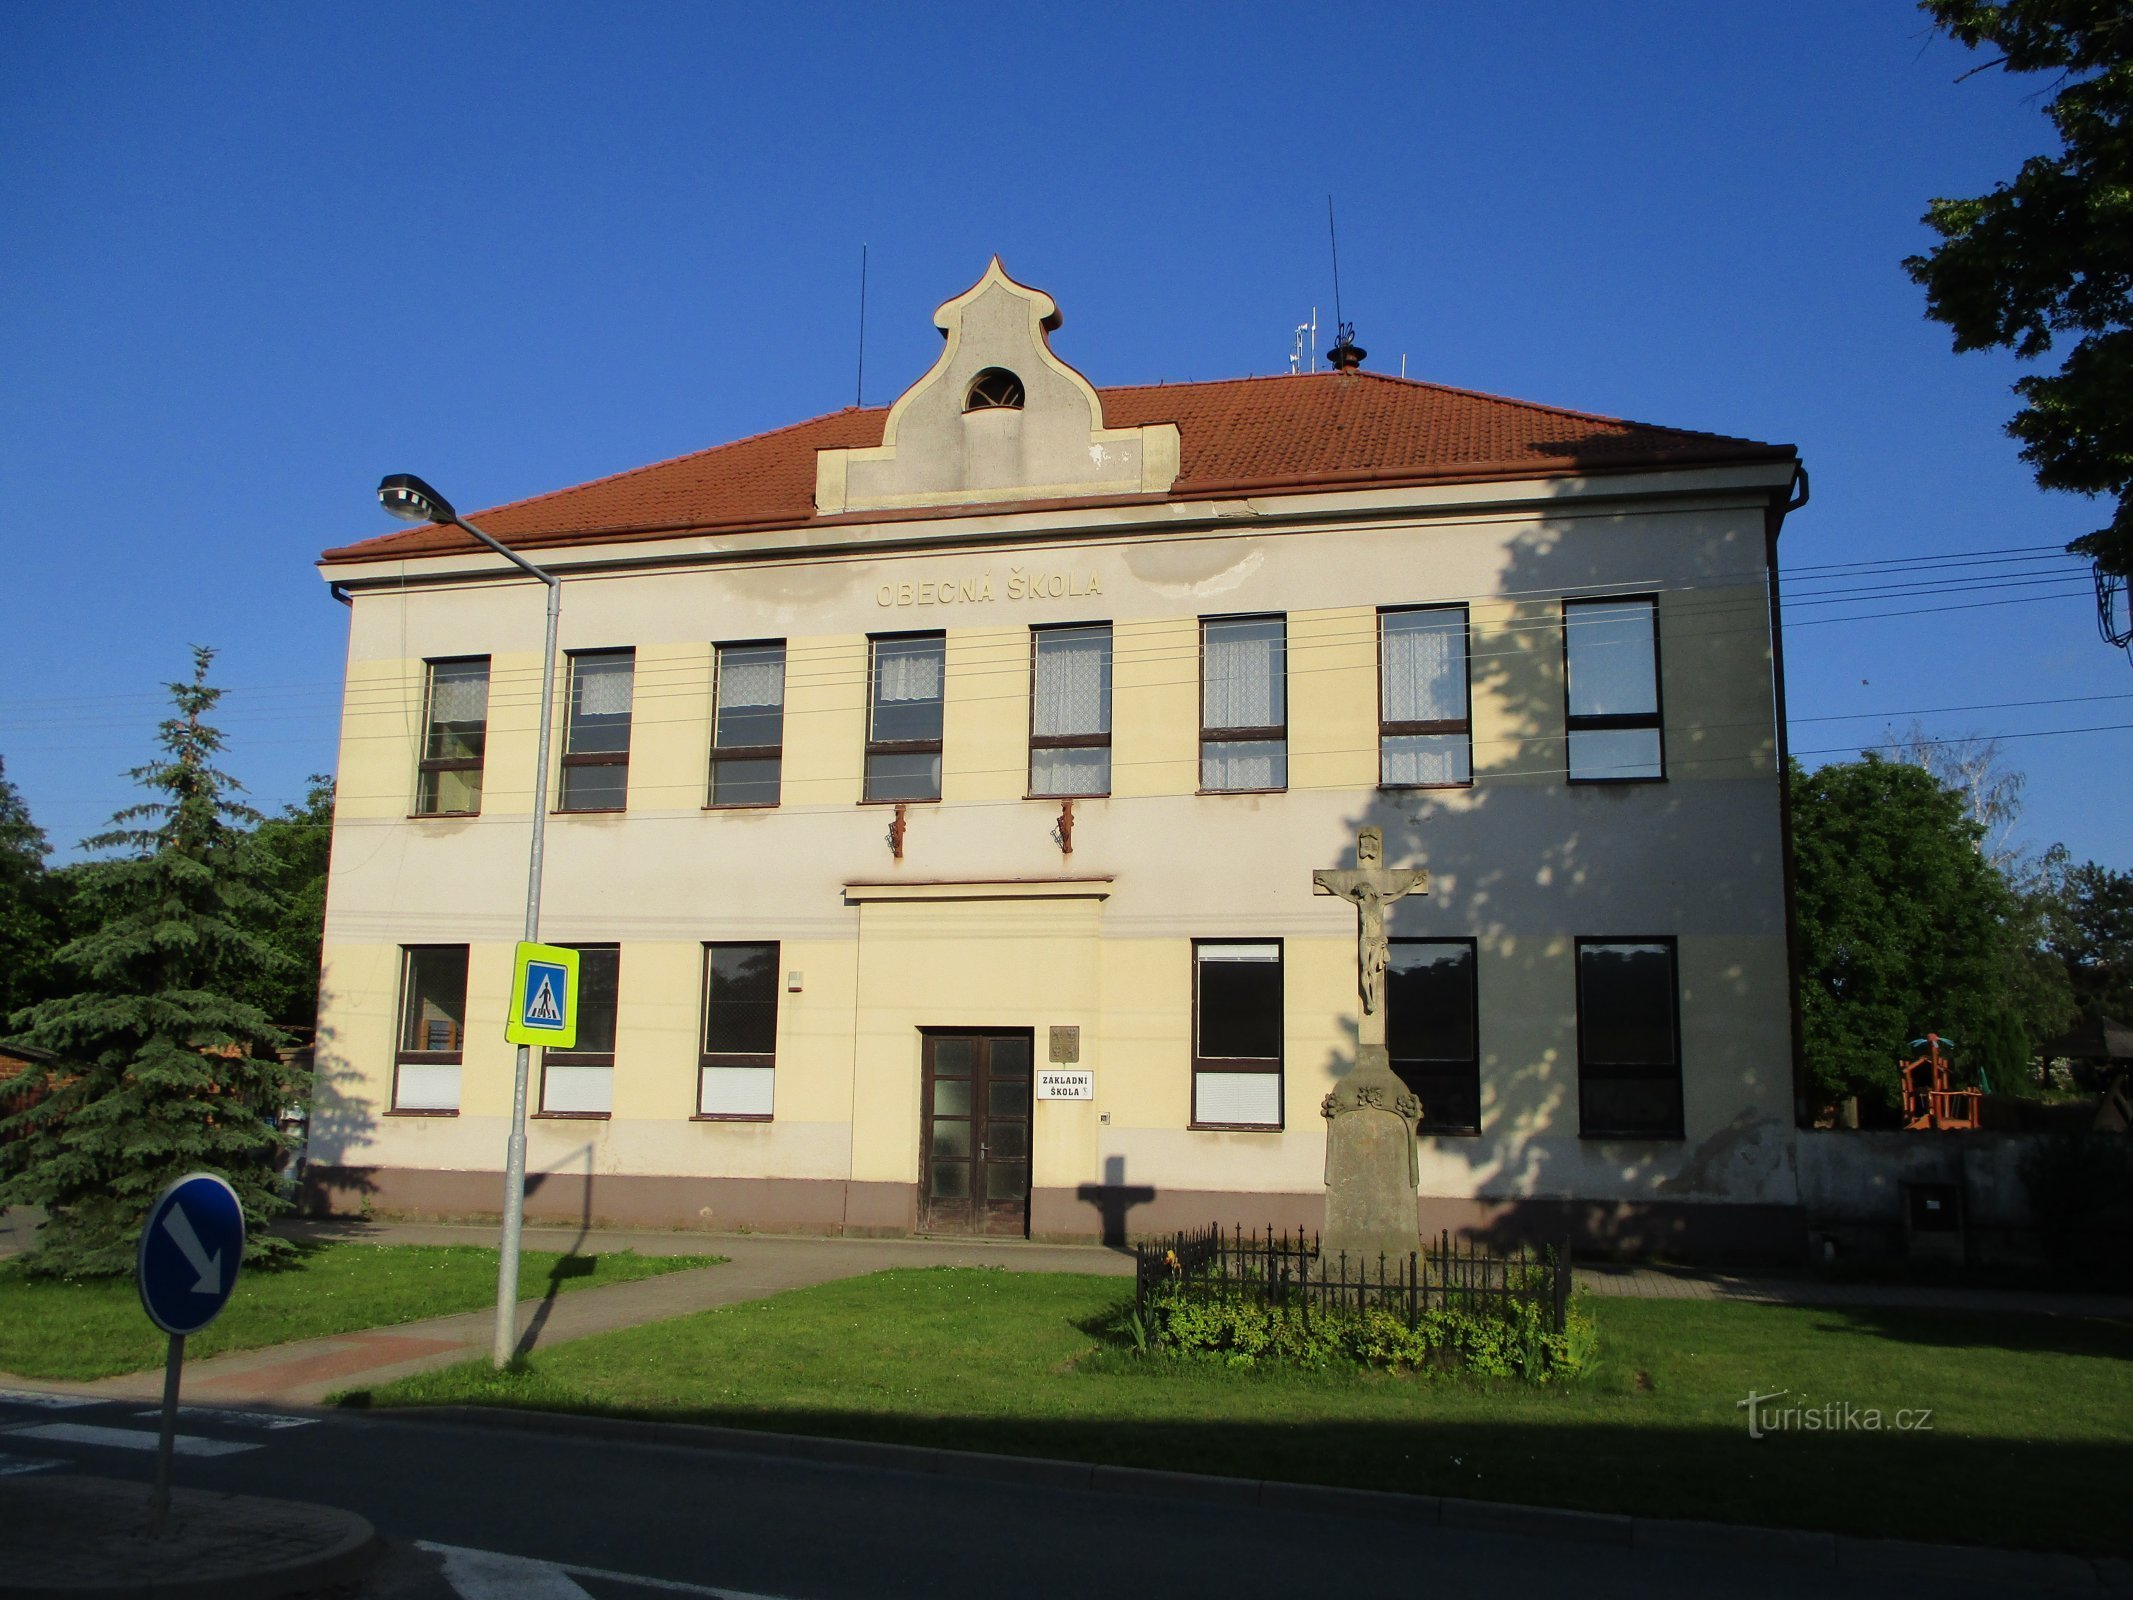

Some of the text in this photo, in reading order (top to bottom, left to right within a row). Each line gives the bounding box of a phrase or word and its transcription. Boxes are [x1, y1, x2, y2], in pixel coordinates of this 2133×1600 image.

[876, 566, 1103, 607] OBECNÁ ŠKOLA
[1042, 1075, 1088, 1085] ZÁKLADNÍ
[1050, 1086, 1080, 1096] ŠKOLA
